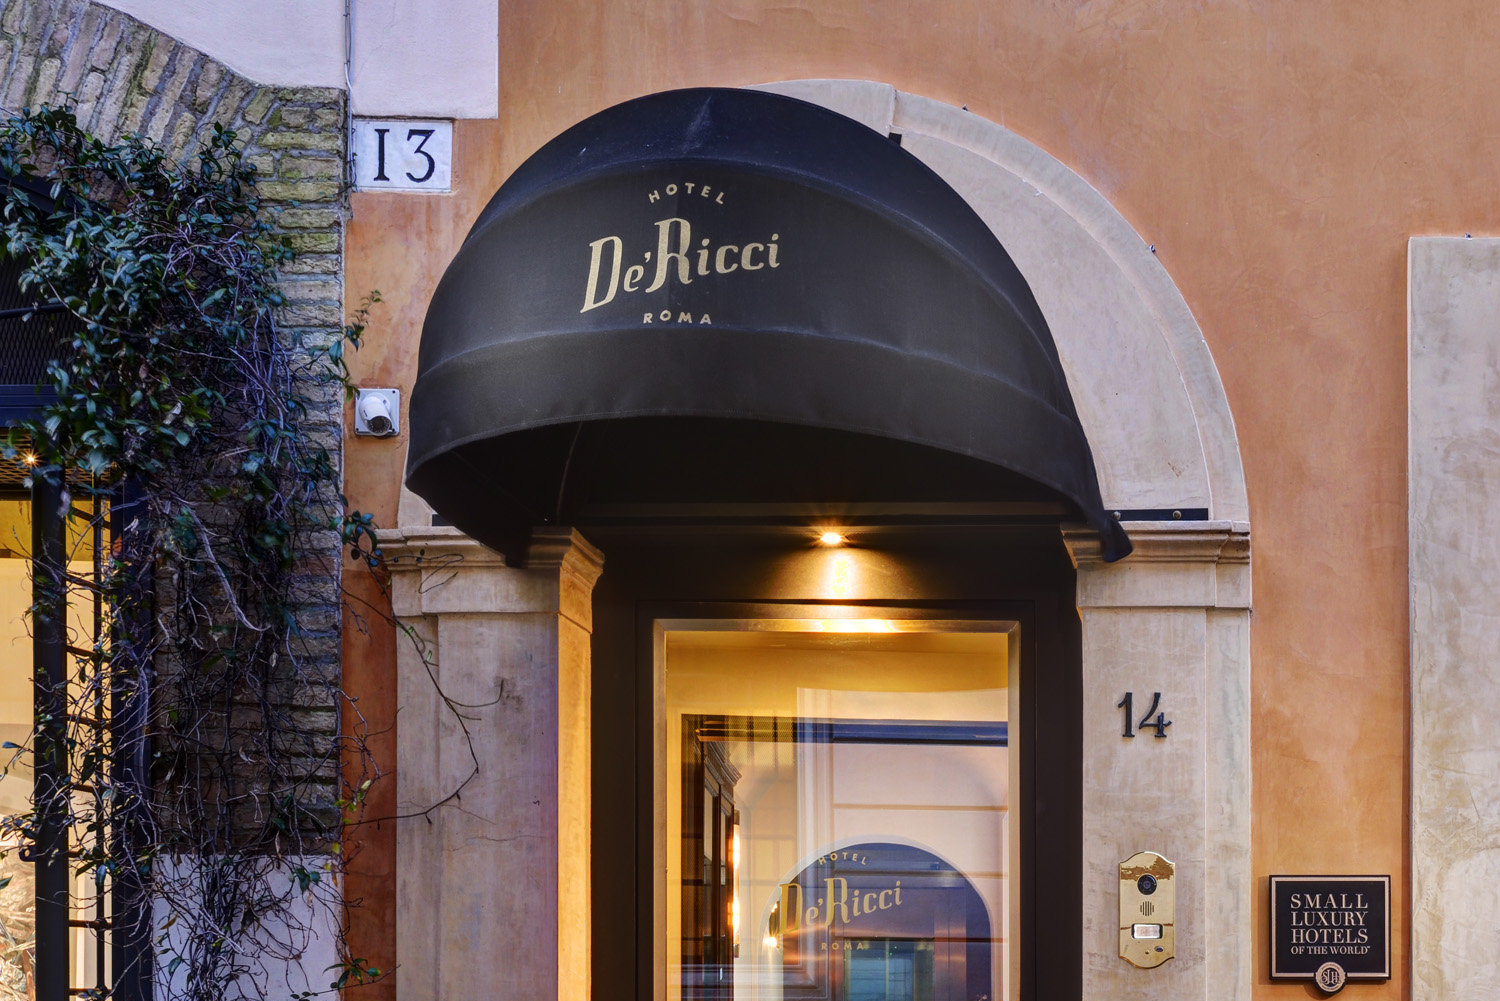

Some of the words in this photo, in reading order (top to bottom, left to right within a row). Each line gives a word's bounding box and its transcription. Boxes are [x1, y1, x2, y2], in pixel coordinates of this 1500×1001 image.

[373, 128, 436, 183] 13
[649, 182, 725, 205] HOTEL
[643, 309, 712, 325] ROMA
[1118, 692, 1172, 738] 14
[817, 852, 867, 866] HOTEL
[1290, 893, 1369, 909] SMALL
[1290, 911, 1369, 926] LUXURY
[1290, 928, 1369, 944] HOTELS
[821, 942, 865, 951] ROMA
[1290, 946, 1305, 955] OF
[1307, 946, 1328, 955] THE
